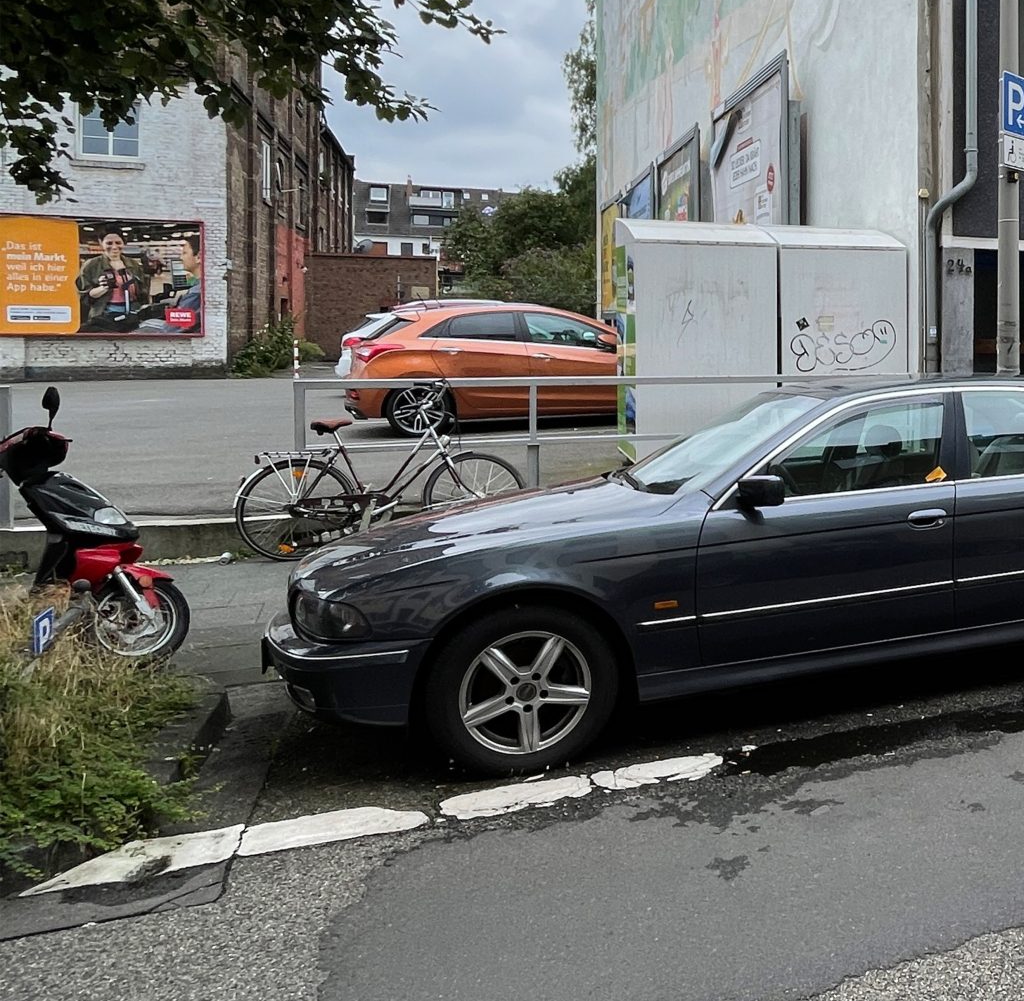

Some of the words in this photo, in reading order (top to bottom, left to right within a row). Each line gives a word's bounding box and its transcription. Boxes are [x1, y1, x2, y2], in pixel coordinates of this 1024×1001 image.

[1008, 80, 1024, 126] P
[28, 242, 43, 251] ist
[29, 263, 45, 271] ich
[946, 258, 972, 275] 24a
[6, 282, 27, 293] App
[38, 617, 51, 655] P
